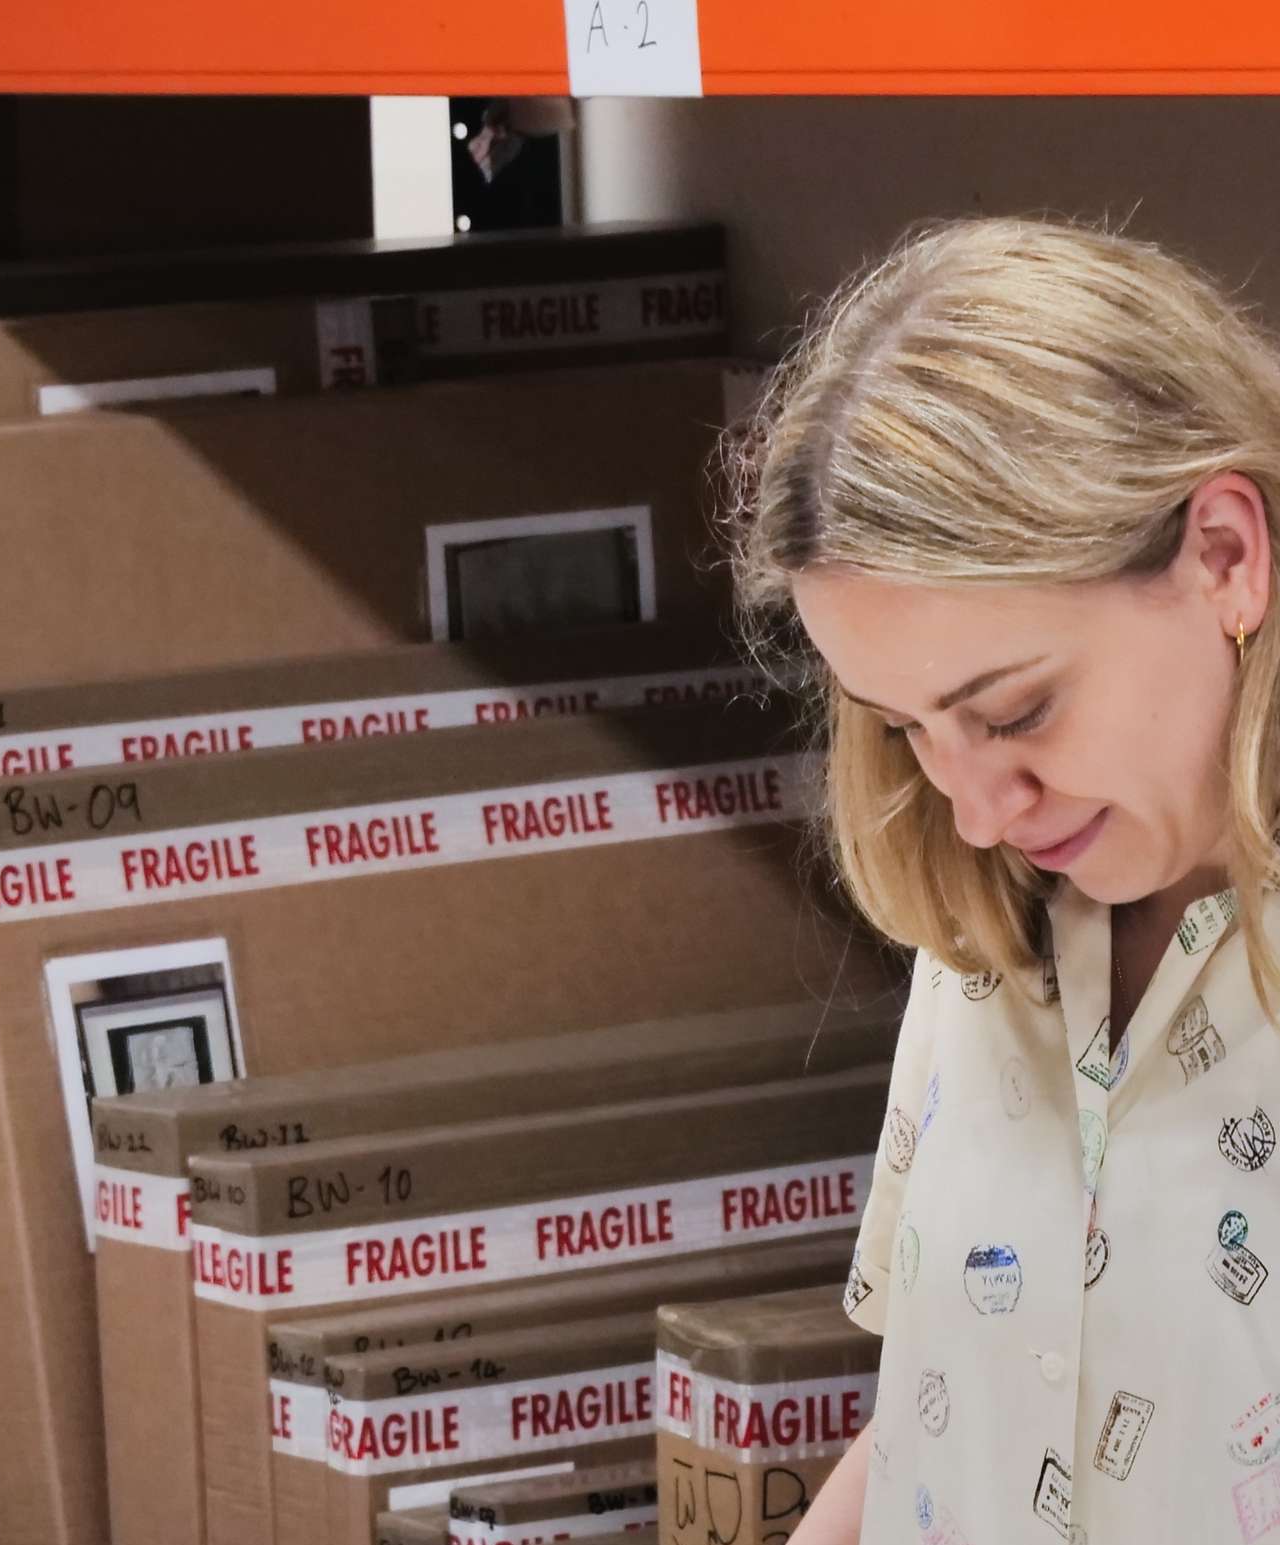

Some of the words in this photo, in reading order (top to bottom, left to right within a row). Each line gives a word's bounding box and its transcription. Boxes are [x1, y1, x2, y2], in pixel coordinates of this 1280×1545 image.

[481, 292, 600, 342] FRAGILE
[3, 783, 143, 837] BW-09
[121, 834, 260, 892] FRAGILE
[306, 812, 440, 867] FRAGILE
[483, 791, 614, 846] FRAGILE
[656, 769, 784, 824] FRAGILE
[346, 1226, 487, 1287] FRAGILE
[536, 1199, 674, 1262] FRAGILE
[723, 1172, 857, 1232] FRAGILE
[511, 1377, 653, 1441] FRAGILE
[714, 1391, 862, 1449] FRAGILE
